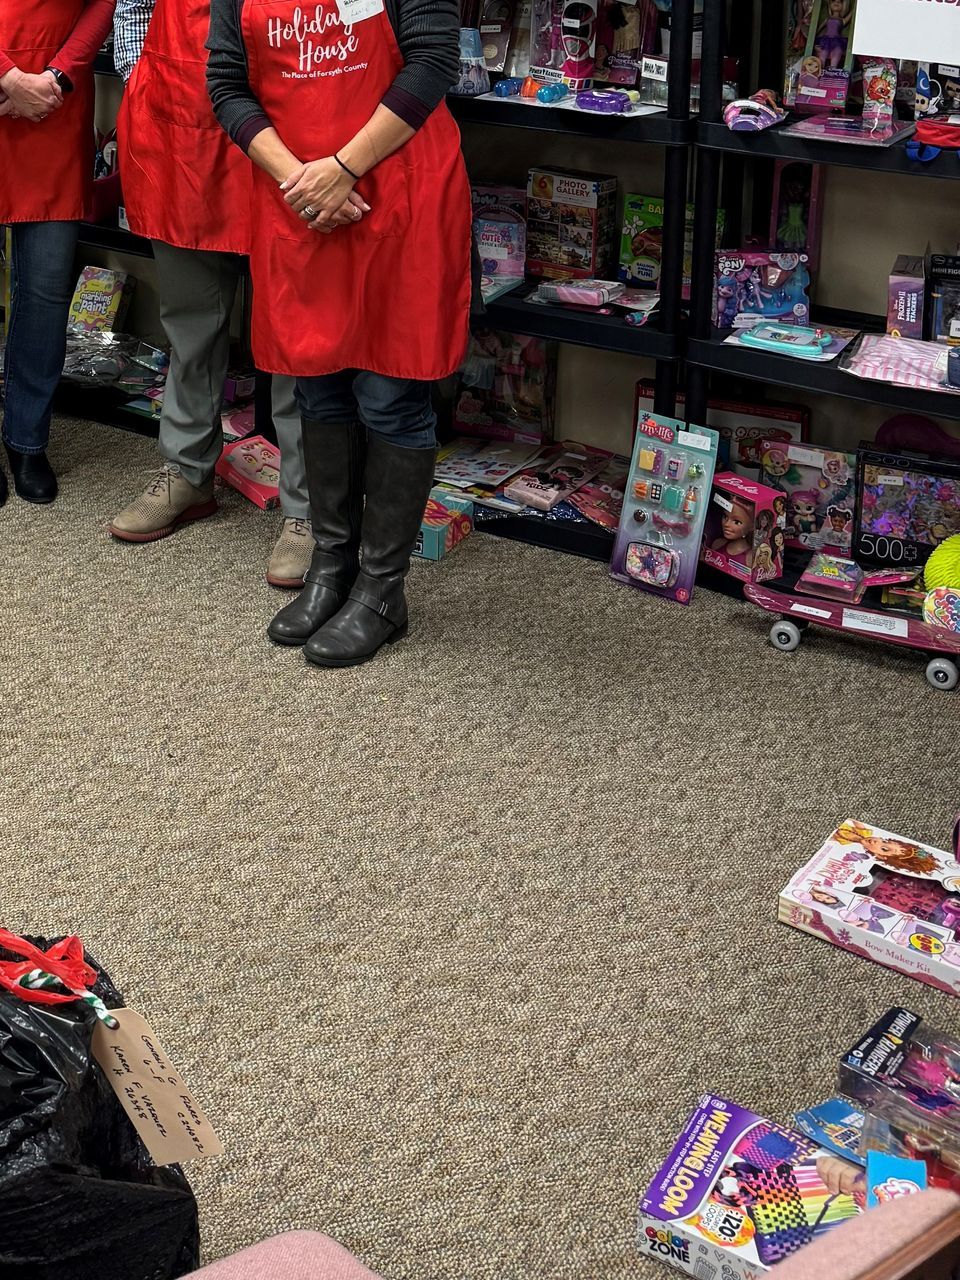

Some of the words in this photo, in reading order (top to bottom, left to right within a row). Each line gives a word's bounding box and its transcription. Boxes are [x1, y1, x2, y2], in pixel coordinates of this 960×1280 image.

[299, 35, 360, 72] House
[291, 71, 308, 79] Place
[317, 68, 343, 77] Forsyth
[343, 62, 368, 73] County
[545, 70, 562, 79] RANGERS
[539, 177, 548, 189] 6
[559, 180, 588, 190] PHOTO
[556, 187, 590, 198] GALLERY
[718, 259, 746, 275] PONY
[79, 300, 107, 314] paint
[80, 290, 113, 305] marbling
[897, 296, 906, 321] FROZEN
[802, 535, 808, 543] 7
[859, 533, 904, 561] 500
[704, 549, 725, 568] Barbie
[755, 566, 778, 583] Barbie
[864, 940, 883, 953] Bow
[885, 949, 914, 966] Maker
[916, 962, 931, 974] Kit
[890, 1009, 917, 1038] POWER
[862, 1036, 899, 1077] RANGERS
[682, 1109, 733, 1171] WEAVING
[711, 1150, 722, 1164] EASY
[703, 1161, 715, 1178] STEP
[658, 1167, 700, 1216] LOOM
[702, 1203, 717, 1228] LOOPS
[718, 1213, 744, 1238] 120
[645, 1226, 691, 1251] color
[649, 1239, 691, 1264] ZONE
